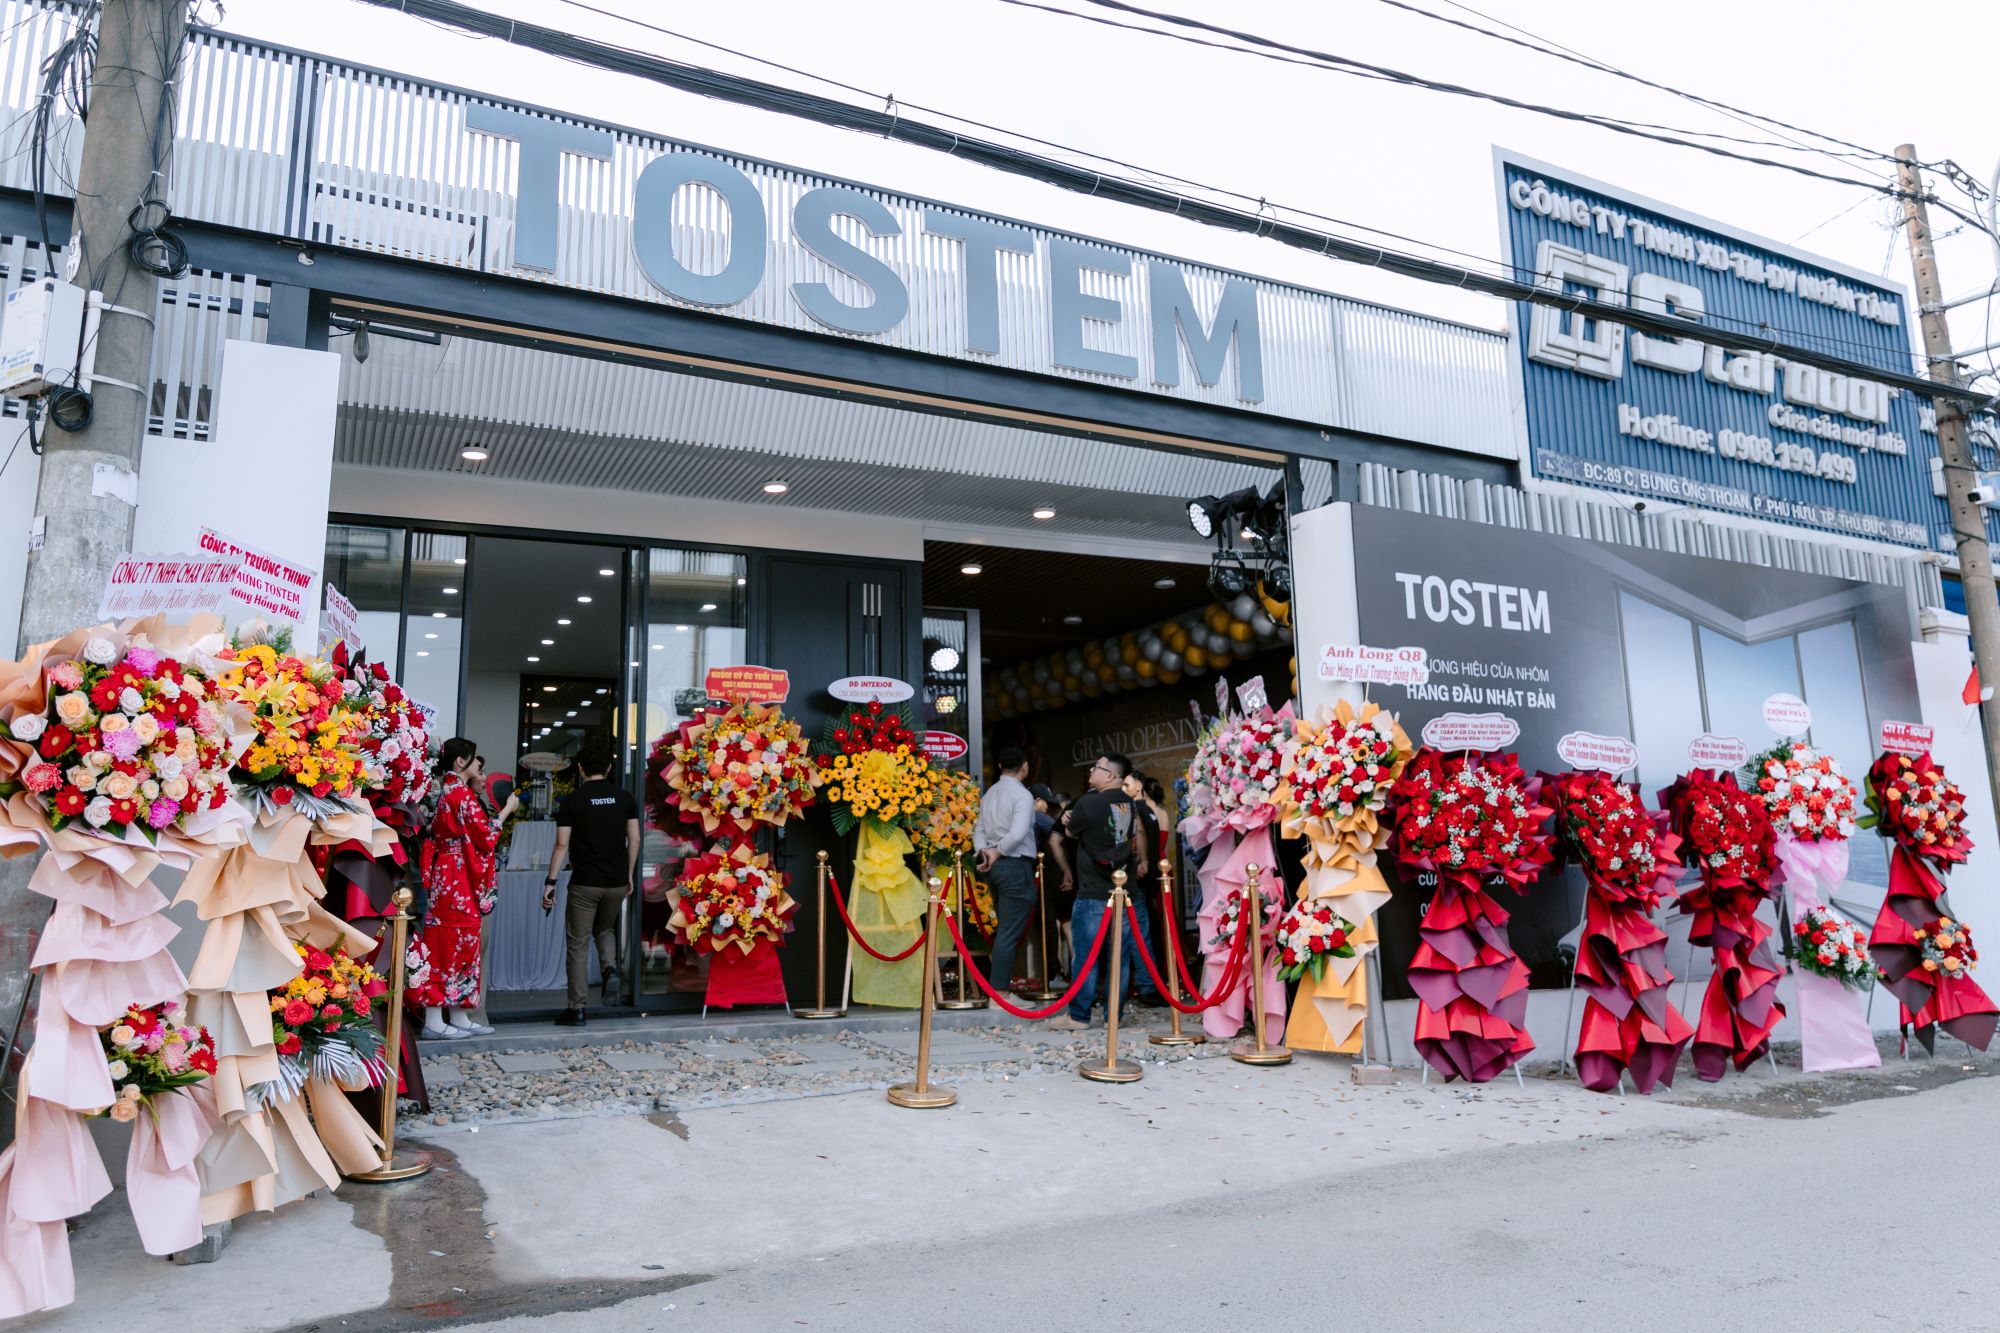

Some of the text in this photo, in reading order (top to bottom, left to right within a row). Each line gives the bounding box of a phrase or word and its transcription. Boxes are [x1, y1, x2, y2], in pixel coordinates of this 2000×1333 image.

[465, 101, 1264, 402] TOSTEM
[1509, 179, 1590, 228] CÔNG
[1591, 205, 1627, 239] TY
[1628, 218, 1696, 262] TNHH
[1797, 274, 1856, 312] NHÂN
[1854, 291, 1899, 326] TÂM
[1618, 403, 1857, 484] Hotline: 0908.199.499
[1640, 473, 1679, 495] BƯNG
[152, 562, 180, 583] TNHH
[217, 563, 240, 583] NAM
[200, 533, 228, 554] CÔNG
[244, 551, 281, 577] TRƯỜNG
[283, 567, 311, 588] THỊNH
[264, 581, 300, 605] TOSTEM
[1395, 572, 1551, 634] TOSTEM
[254, 594, 278, 614] Hồng
[280, 603, 300, 619] Phát
[1326, 646, 1422, 662] Anh Long Q8
[1461, 661, 1488, 678] HIỆU
[1490, 661, 1514, 679] CỦA
[1516, 666, 1550, 682] NHÔM
[1452, 683, 1483, 704] ĐẦU
[1486, 687, 1524, 708] NHẬT
[1527, 688, 1556, 709] BẢN
[412, 702, 435, 717] NCEPT
[590, 797, 616, 805] TOSTEM
